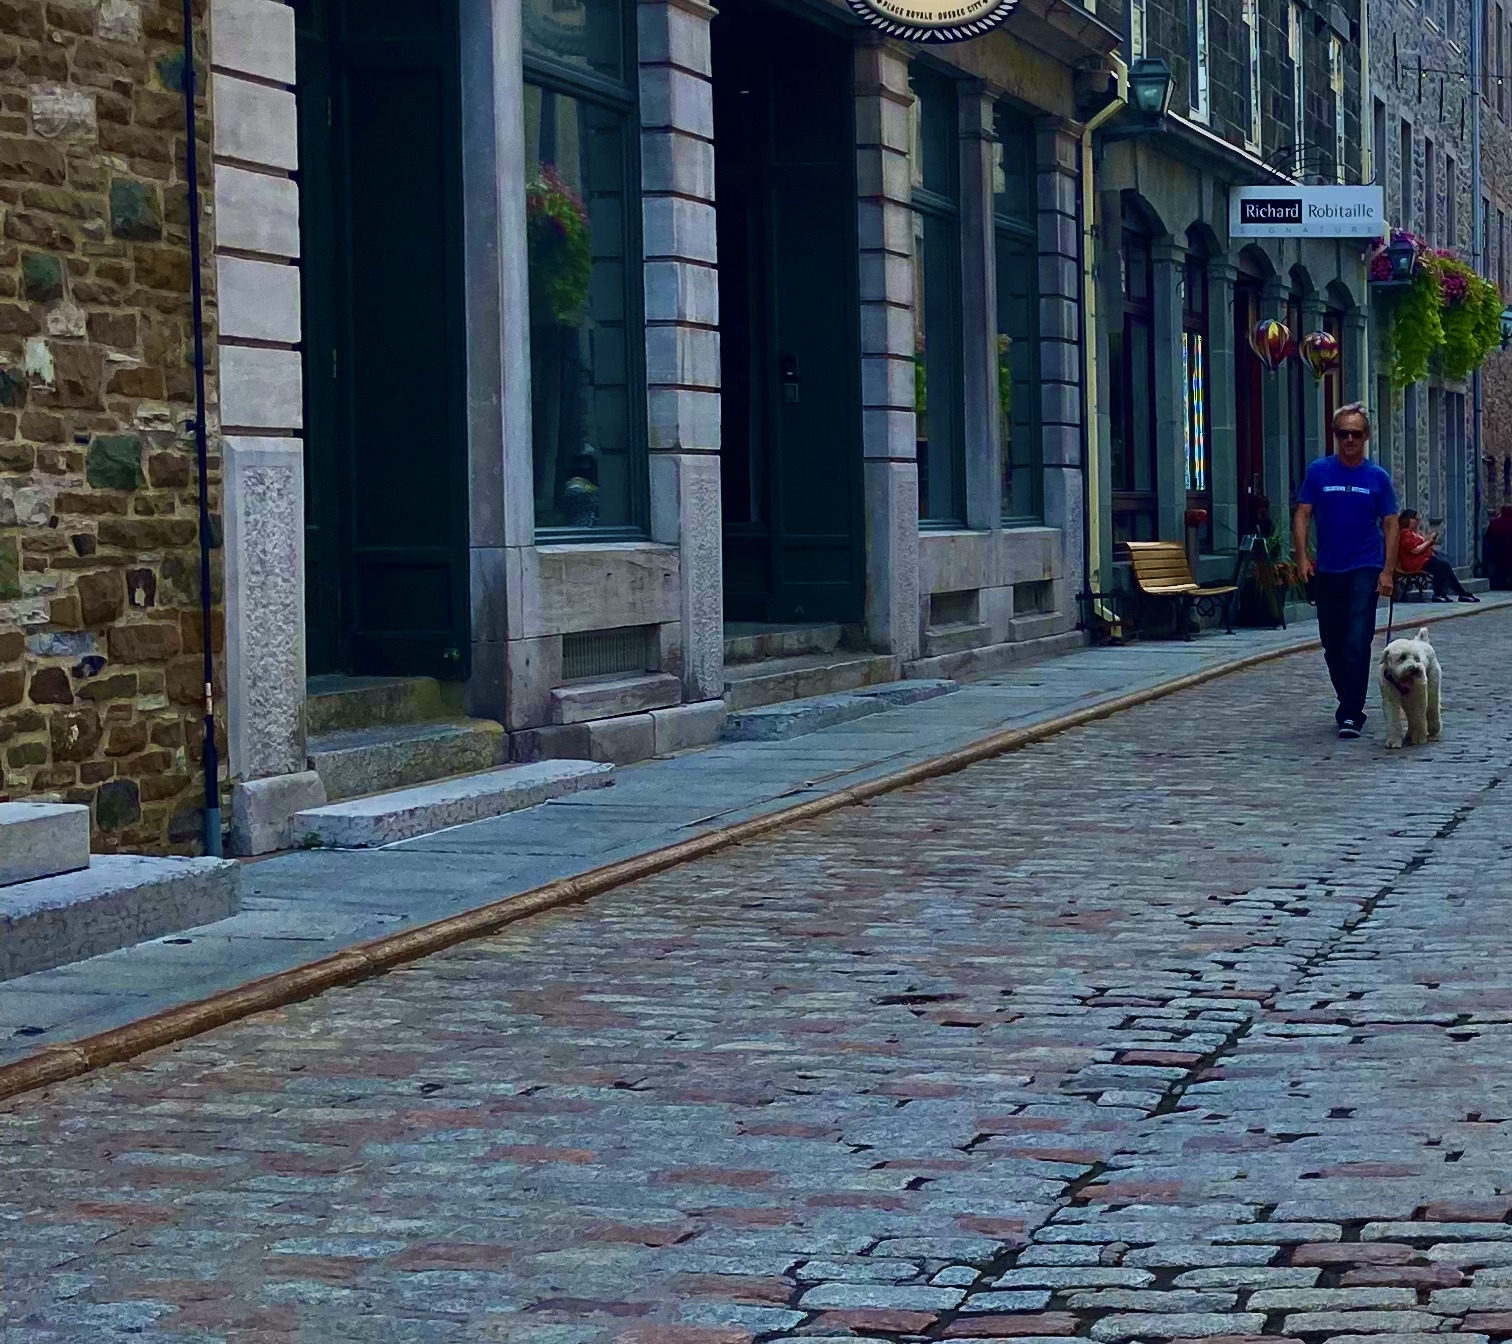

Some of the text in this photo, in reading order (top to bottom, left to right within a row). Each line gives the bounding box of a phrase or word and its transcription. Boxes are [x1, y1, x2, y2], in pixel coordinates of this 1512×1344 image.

[882, 0, 905, 16] PLACE
[906, 8, 933, 21] ROYALE
[967, 0, 983, 14] CITY
[1246, 203, 1374, 219] Richard Robitaille
[1240, 225, 1373, 235] SIGNATURE
